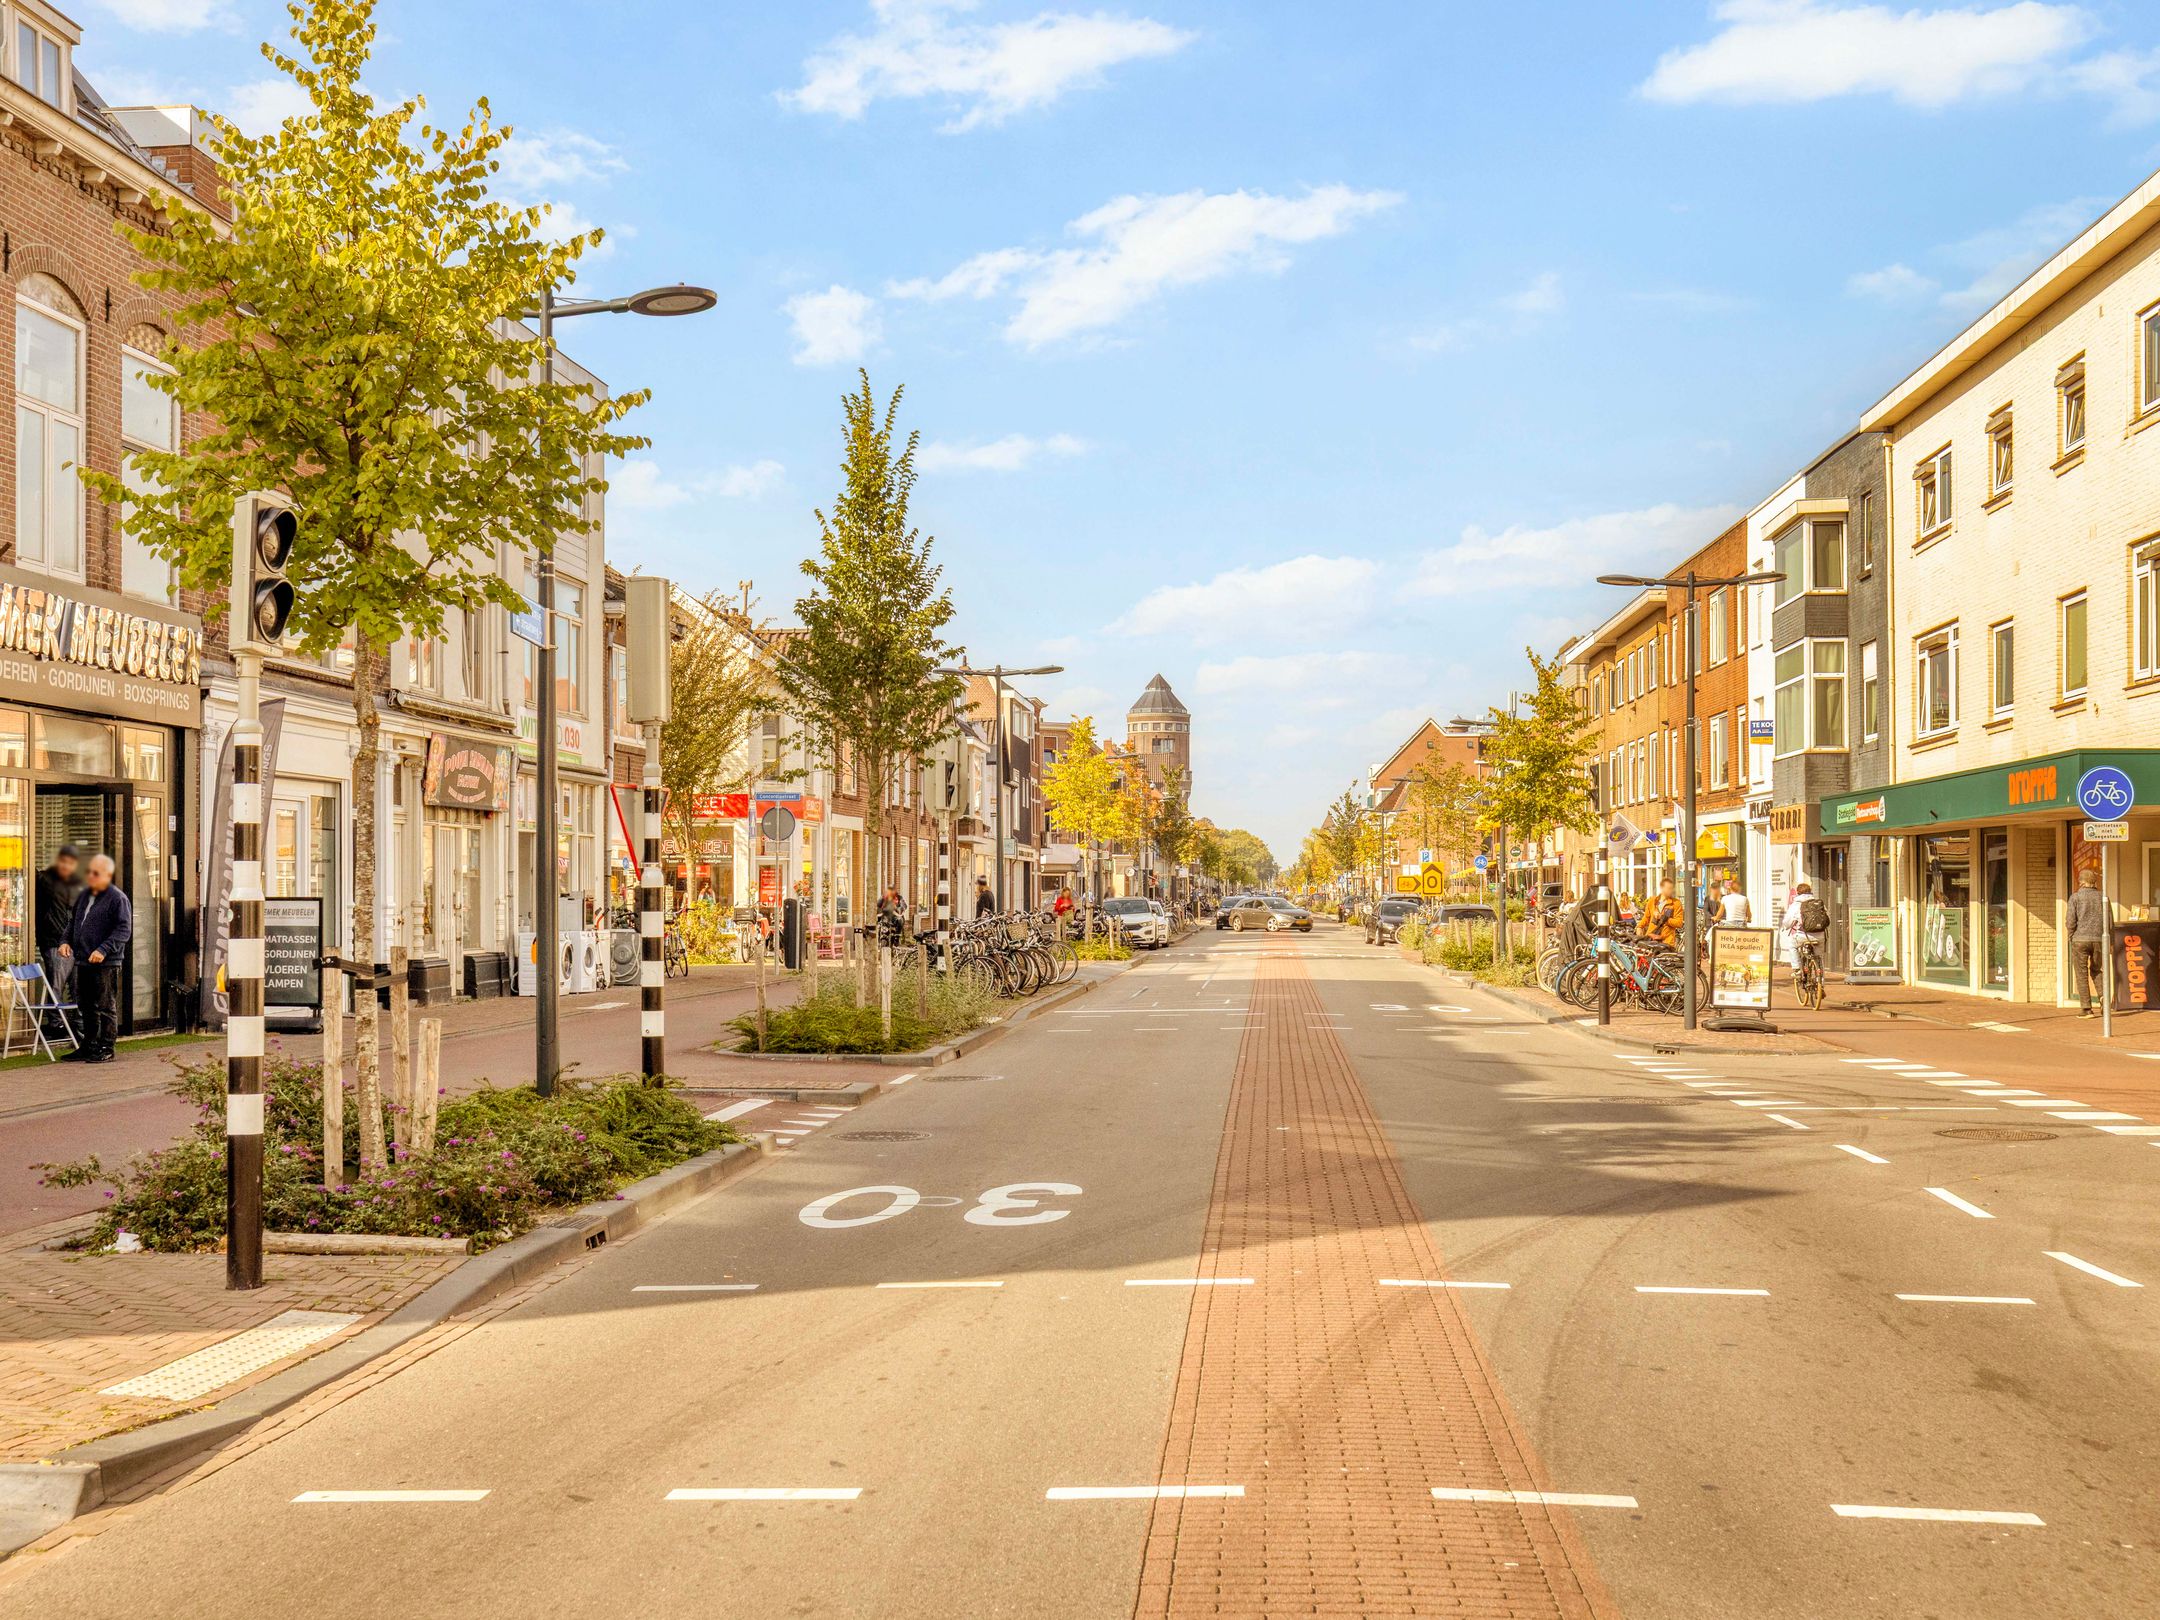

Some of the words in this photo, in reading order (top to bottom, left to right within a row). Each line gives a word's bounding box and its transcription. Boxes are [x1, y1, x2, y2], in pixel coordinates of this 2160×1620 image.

[70, 601, 202, 686] MEUBELEN
[0, 661, 38, 685] EREN
[49, 668, 115, 698] GORDIJNEN
[124, 684, 190, 711] BOXSPRINGS
[564, 726, 580, 750] 030
[281, 908, 315, 916] MEUBELEN
[264, 935, 317, 943] MATRASSEN
[264, 949, 316, 958] GORDIJNEN
[1736, 944, 1764, 952] spullen?
[799, 1182, 1083, 1229] 30
